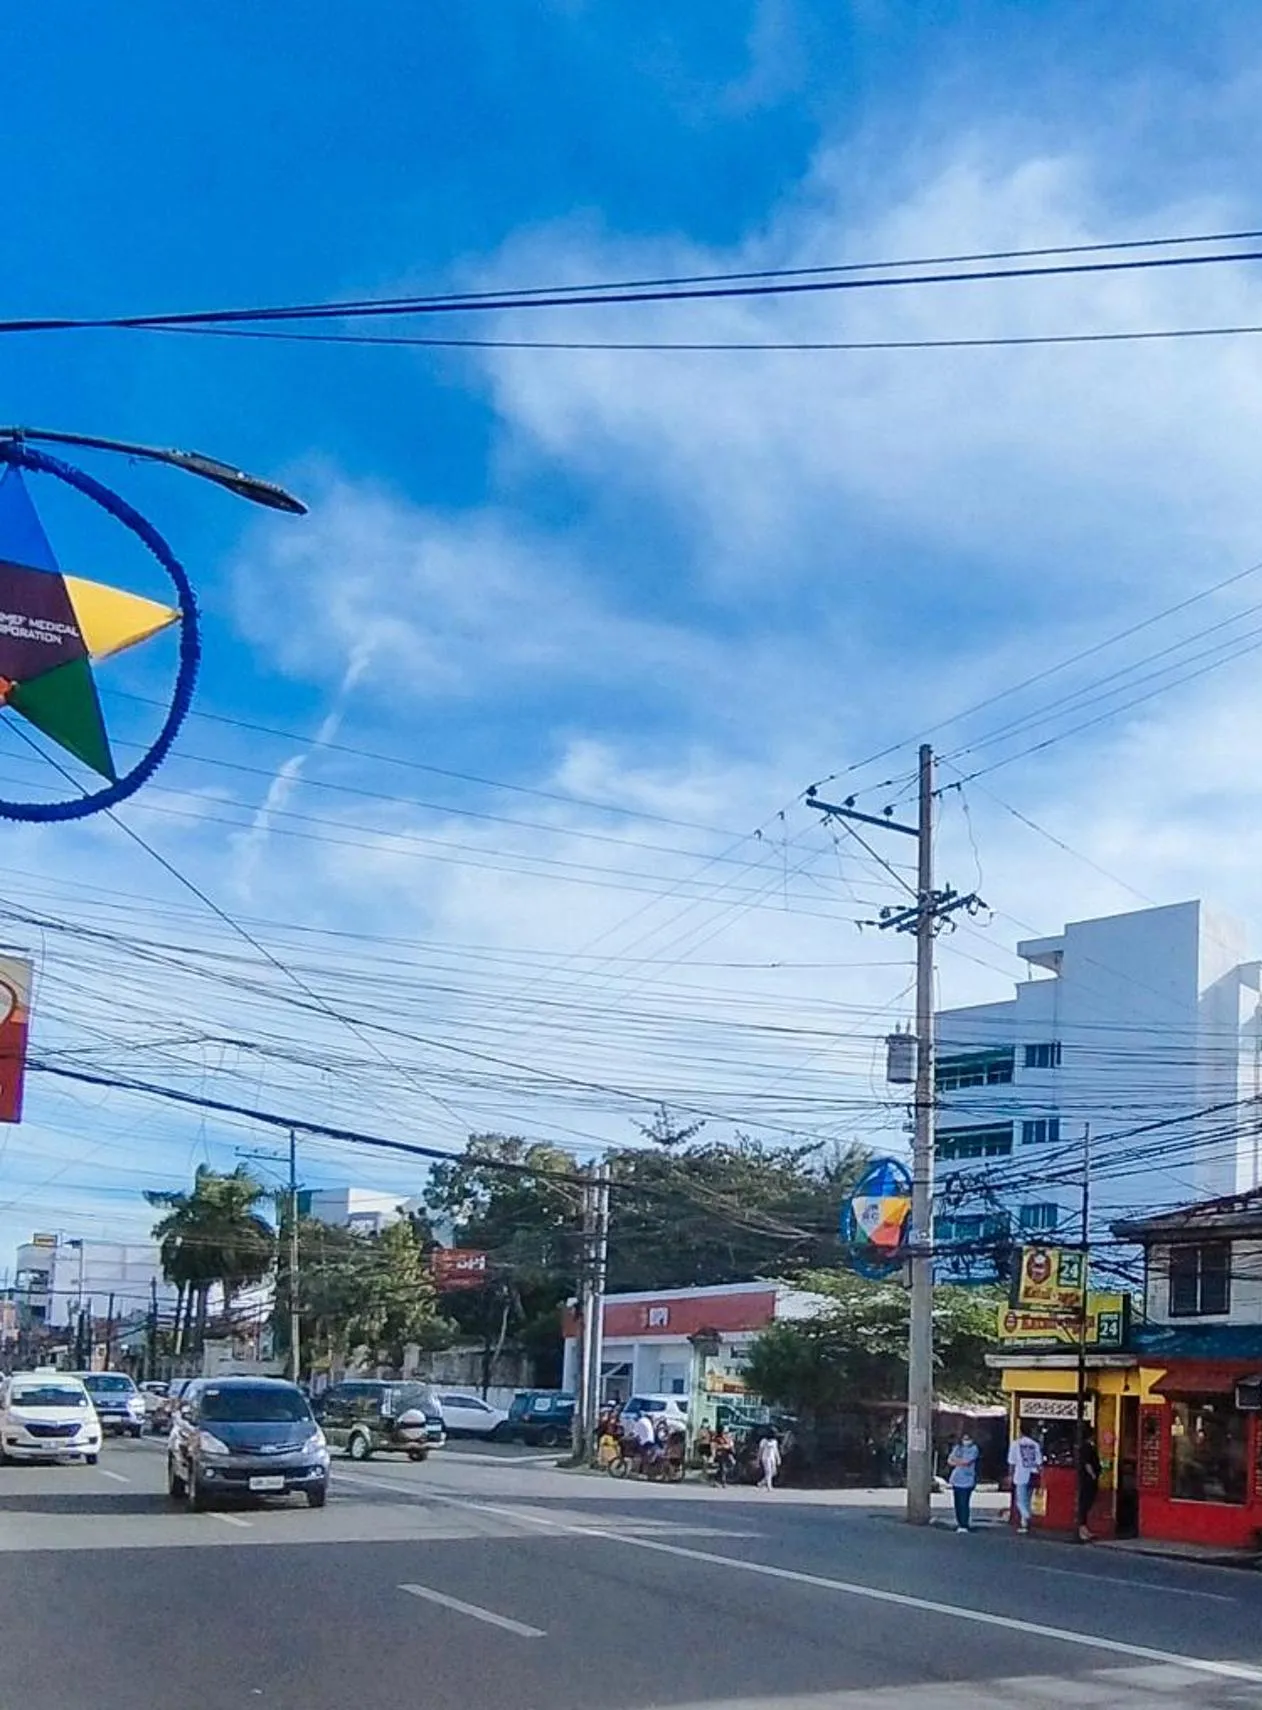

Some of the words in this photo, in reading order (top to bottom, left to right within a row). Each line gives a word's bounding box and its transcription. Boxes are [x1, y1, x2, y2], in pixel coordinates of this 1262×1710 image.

[28, 617, 80, 638] MEDICAL
[1060, 1262, 1080, 1279] 24
[1100, 1321, 1118, 1337] 24
